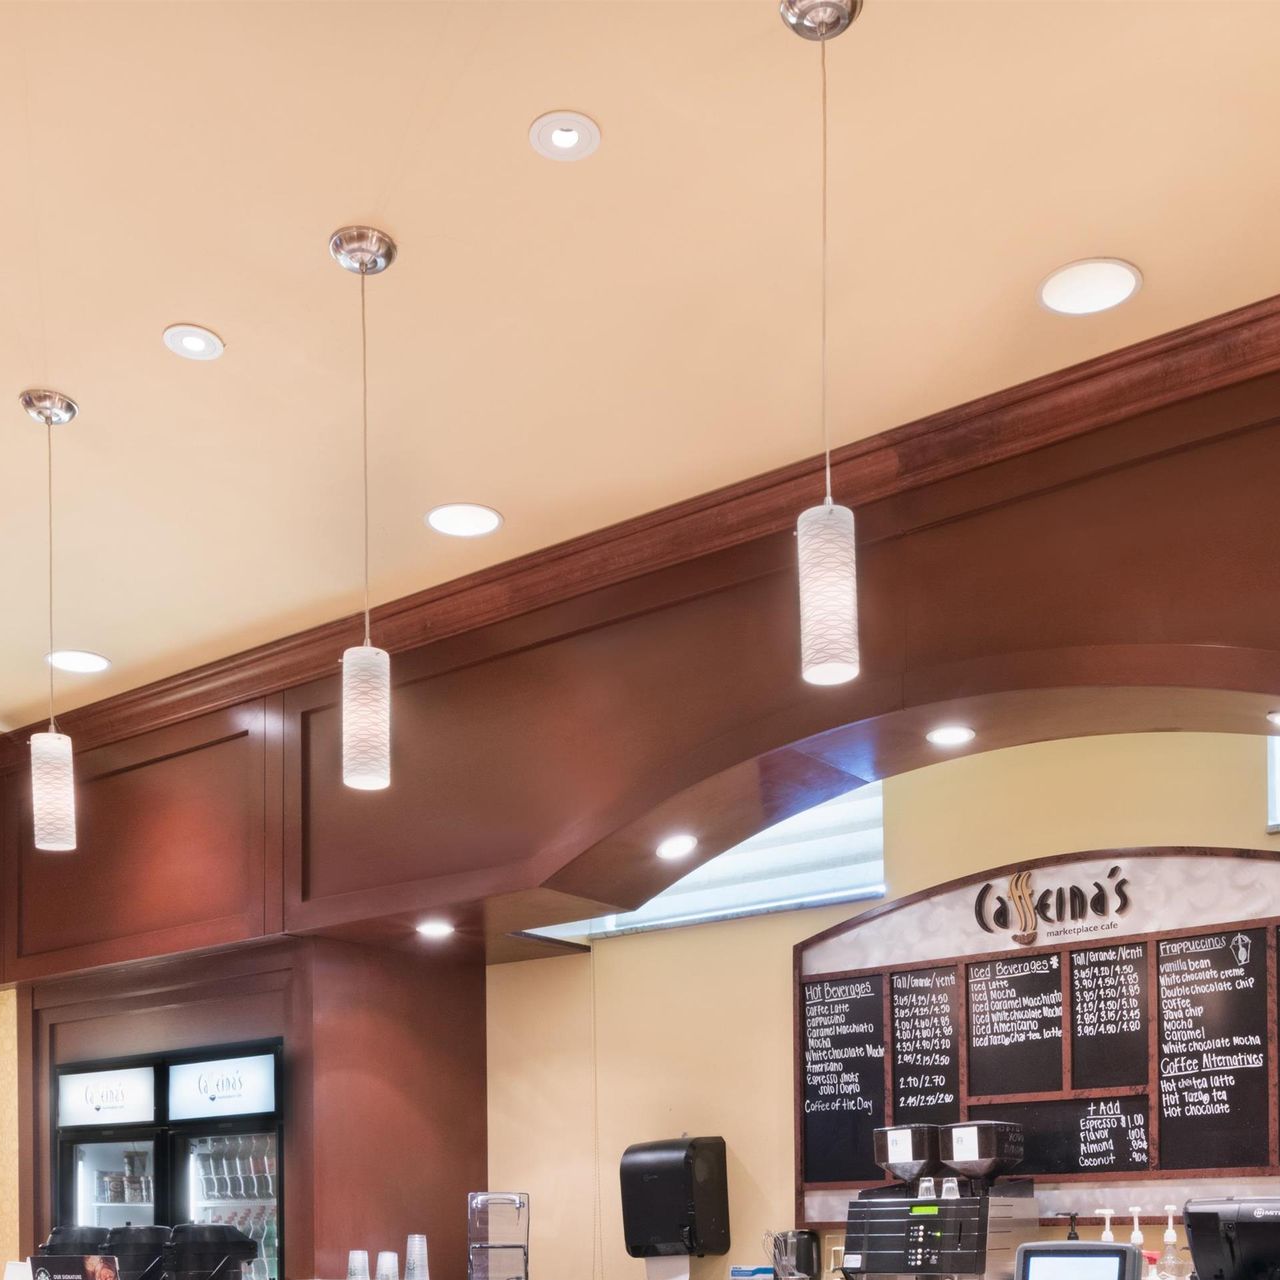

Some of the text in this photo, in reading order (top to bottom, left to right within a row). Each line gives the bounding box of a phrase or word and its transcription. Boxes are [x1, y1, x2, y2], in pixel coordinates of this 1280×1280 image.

[1046, 921, 1118, 938] marketplace cafe
[1159, 935, 1226, 955] Frappuccinos
[970, 959, 1049, 979] Iced Beverages
[1188, 957, 1211, 970] bean
[1181, 969, 1218, 984] chocolate
[1220, 966, 1245, 979] creme
[805, 982, 872, 1000] Hot Beverages
[971, 982, 986, 992] Iced
[972, 988, 1016, 1001] Iced Mocha
[1161, 985, 1190, 999] Double
[1190, 981, 1232, 994] chocolate
[972, 1000, 989, 1013] Iced
[972, 1012, 990, 1024] Iced
[1163, 1018, 1192, 1031] Mocha
[972, 1020, 1038, 1036] Iced Americano
[808, 1038, 831, 1049] Mocha
[972, 1034, 988, 1047] Iced
[1188, 1036, 1230, 1051] chocolate
[1233, 1035, 1261, 1046] Mocha
[806, 1062, 843, 1073] Americano
[1160, 1052, 1263, 1074] Coffee Alternatives
[807, 1074, 837, 1085] Espresso
[1160, 1079, 1177, 1092] Hot
[1192, 1077, 1208, 1089] tea
[1210, 1074, 1235, 1087] latte
[805, 1096, 873, 1115] Coffee of the Day
[1162, 1090, 1227, 1107] Hot tea
[1099, 1100, 1120, 1115] Add
[1164, 1103, 1230, 1118] Hot chocolate
[1079, 1117, 1118, 1131] Espresso
[1080, 1128, 1109, 1142] Flavor
[1080, 1139, 1114, 1155] Almond
[1078, 1155, 1116, 1167] Coconut
